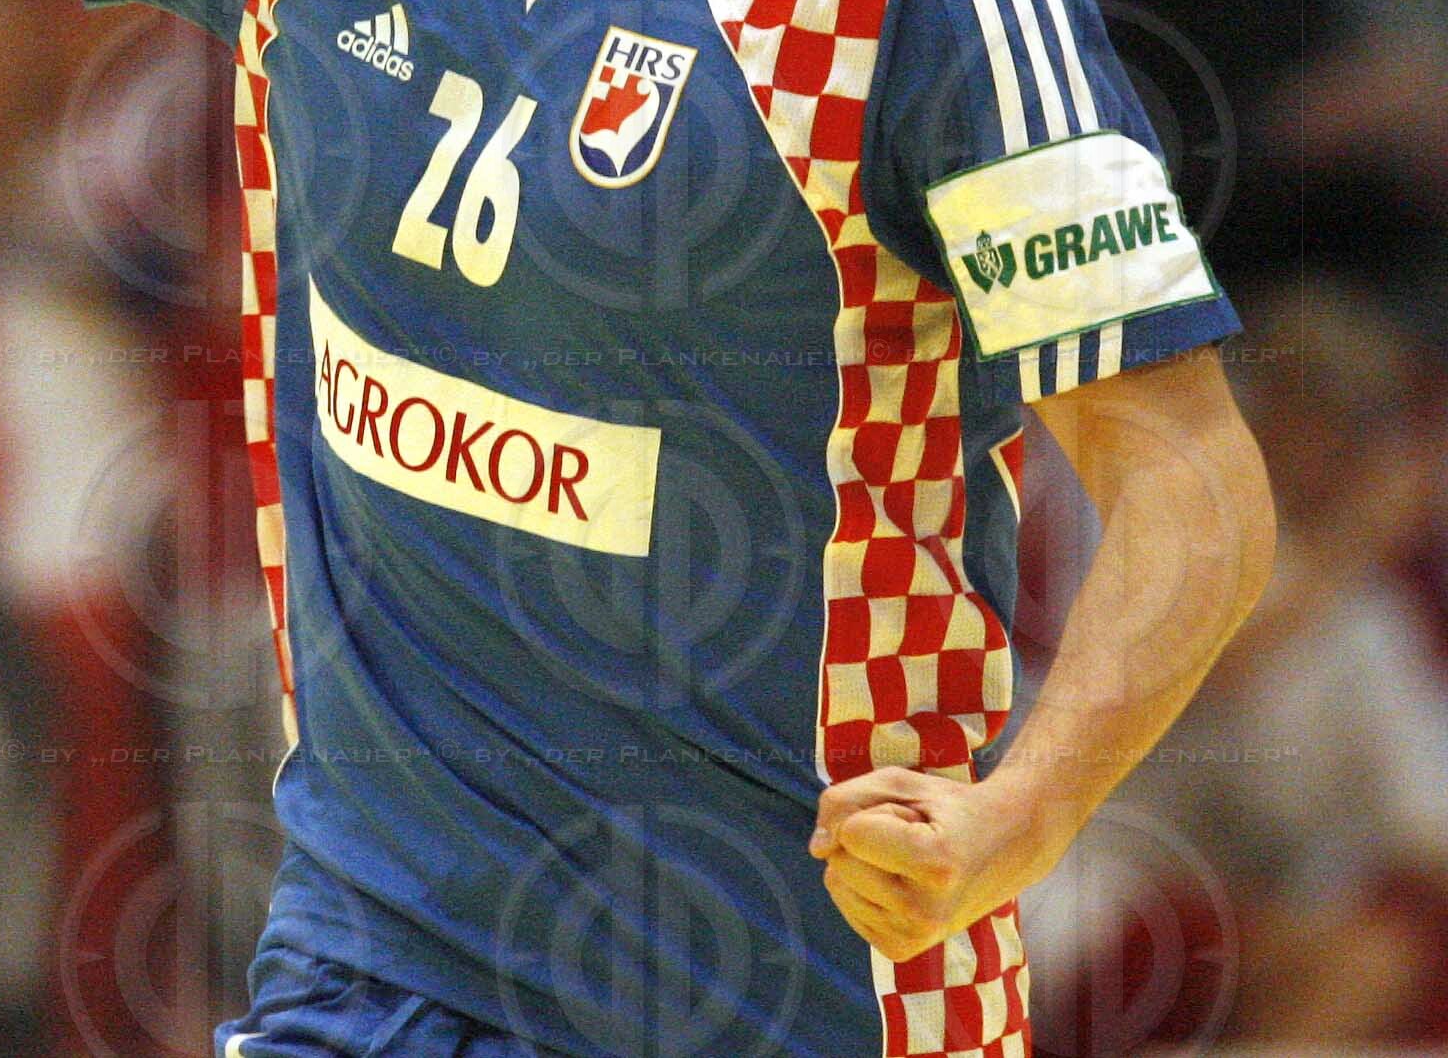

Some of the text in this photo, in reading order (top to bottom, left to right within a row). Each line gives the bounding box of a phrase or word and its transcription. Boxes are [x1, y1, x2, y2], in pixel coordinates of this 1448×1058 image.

[337, 28, 415, 82] adidas
[606, 37, 686, 81] HRS
[391, 69, 539, 288] 26
[1024, 202, 1179, 281] GRAWE
[319, 338, 590, 522] AGROKOR
